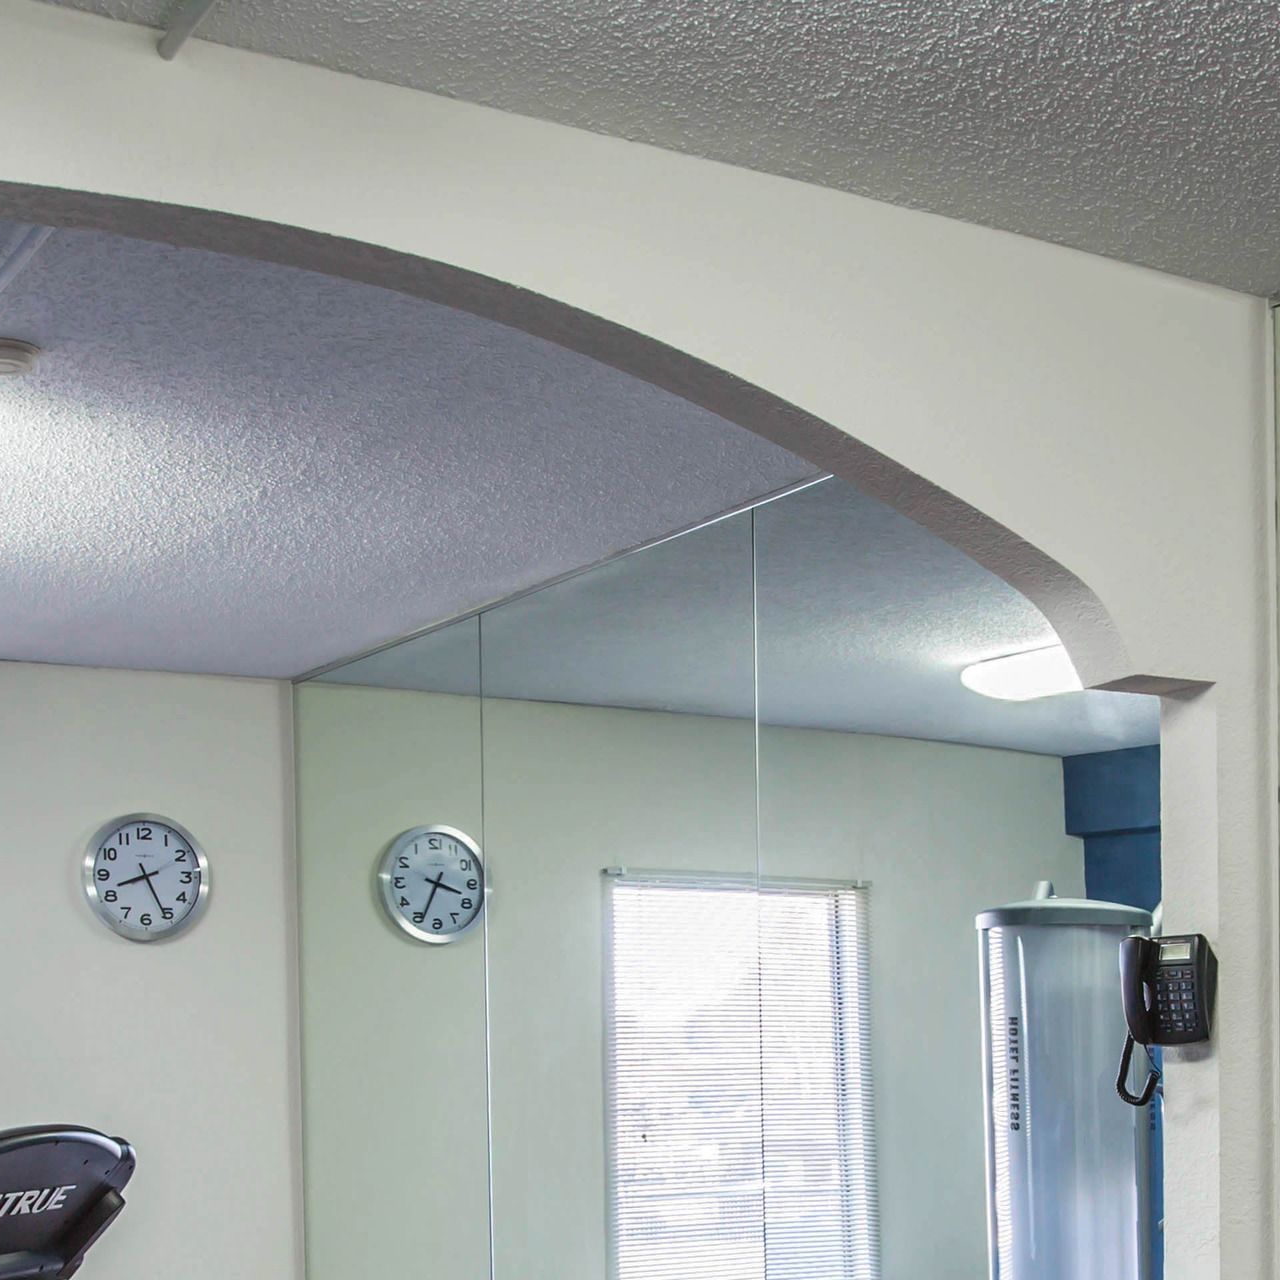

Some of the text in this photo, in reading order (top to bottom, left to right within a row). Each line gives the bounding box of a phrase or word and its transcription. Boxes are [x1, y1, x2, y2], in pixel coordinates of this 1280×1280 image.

[118, 832, 130, 846] 11
[136, 827, 153, 841] 12
[164, 834, 168, 847] 1
[103, 847, 117, 861] 10
[174, 849, 187, 862] 2
[97, 868, 110, 881] 9
[179, 871, 193, 884] 3
[103, 889, 118, 902] 8
[175, 891, 188, 904] 4
[120, 906, 132, 919] 7
[161, 907, 174, 920] 5
[139, 913, 153, 926] 6
